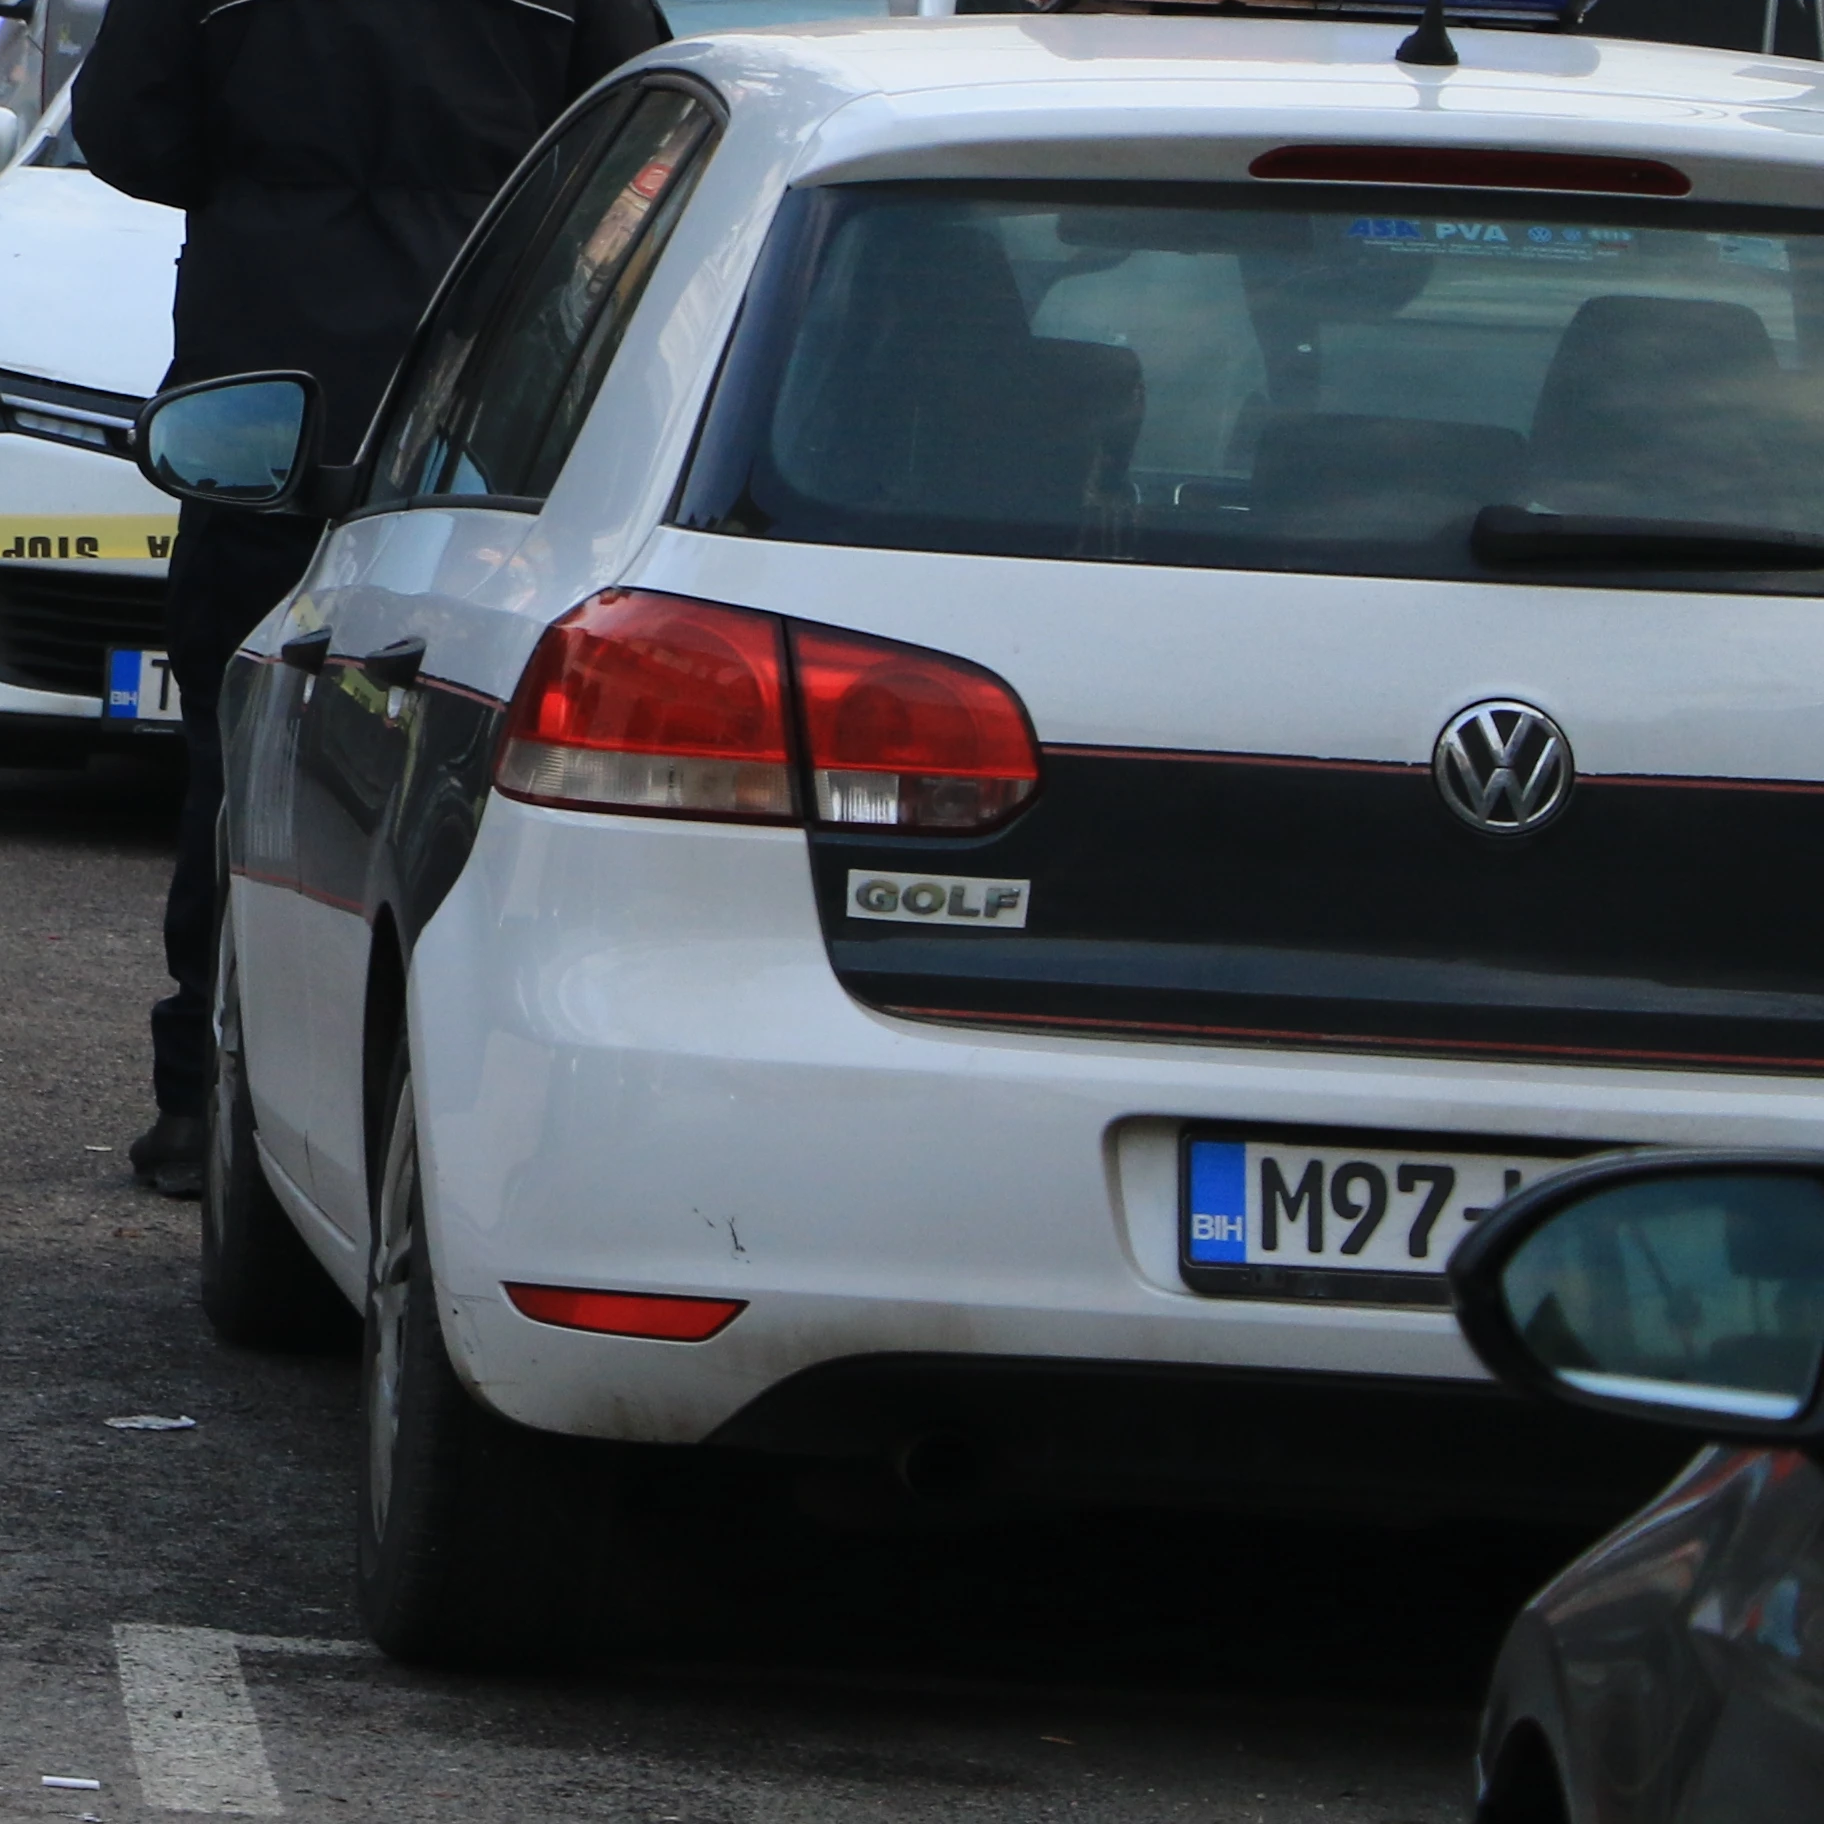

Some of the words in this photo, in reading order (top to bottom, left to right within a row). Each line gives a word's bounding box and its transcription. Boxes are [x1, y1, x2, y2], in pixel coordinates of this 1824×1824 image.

[1435, 223, 1509, 243] PVA
[110, 691, 137, 705] BIH
[856, 879, 1020, 918] GOLF
[1192, 1214, 1243, 1241] BIH
